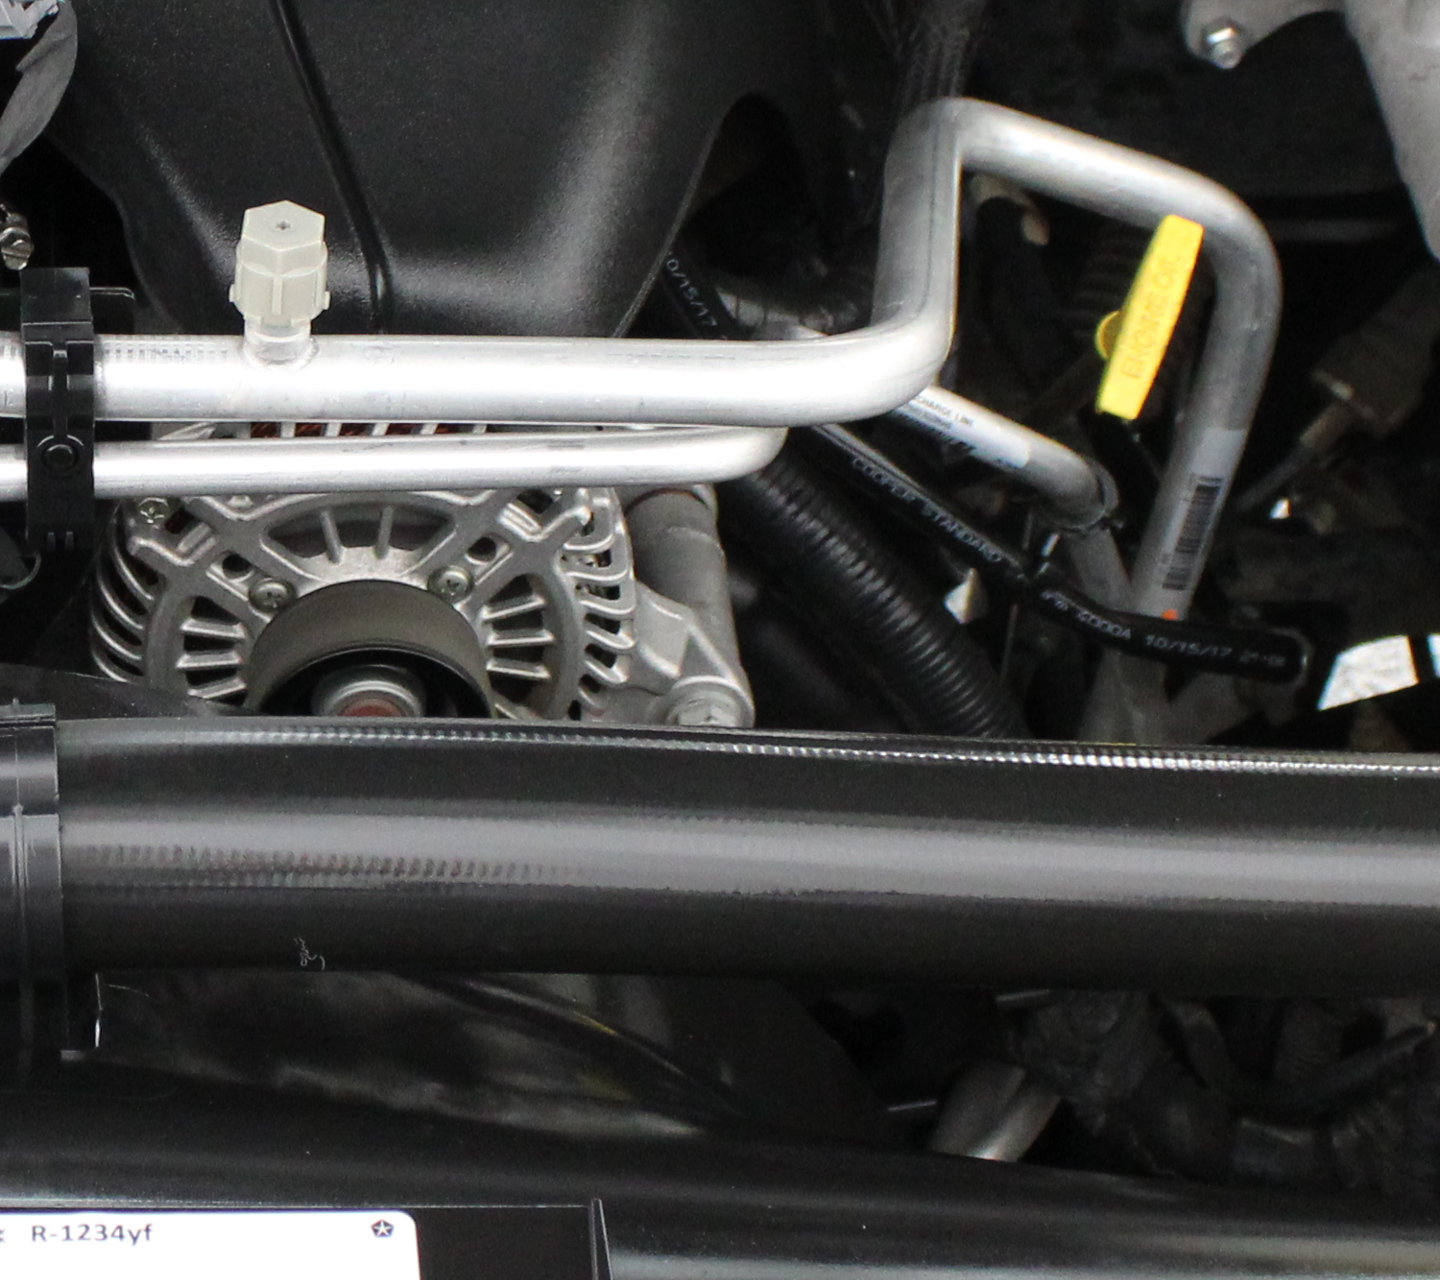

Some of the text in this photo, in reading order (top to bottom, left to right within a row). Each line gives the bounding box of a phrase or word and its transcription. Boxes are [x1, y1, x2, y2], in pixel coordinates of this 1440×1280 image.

[850, 456, 1004, 563] COOPER STANDARD
[29, 1222, 154, 1249] R-1234yf
